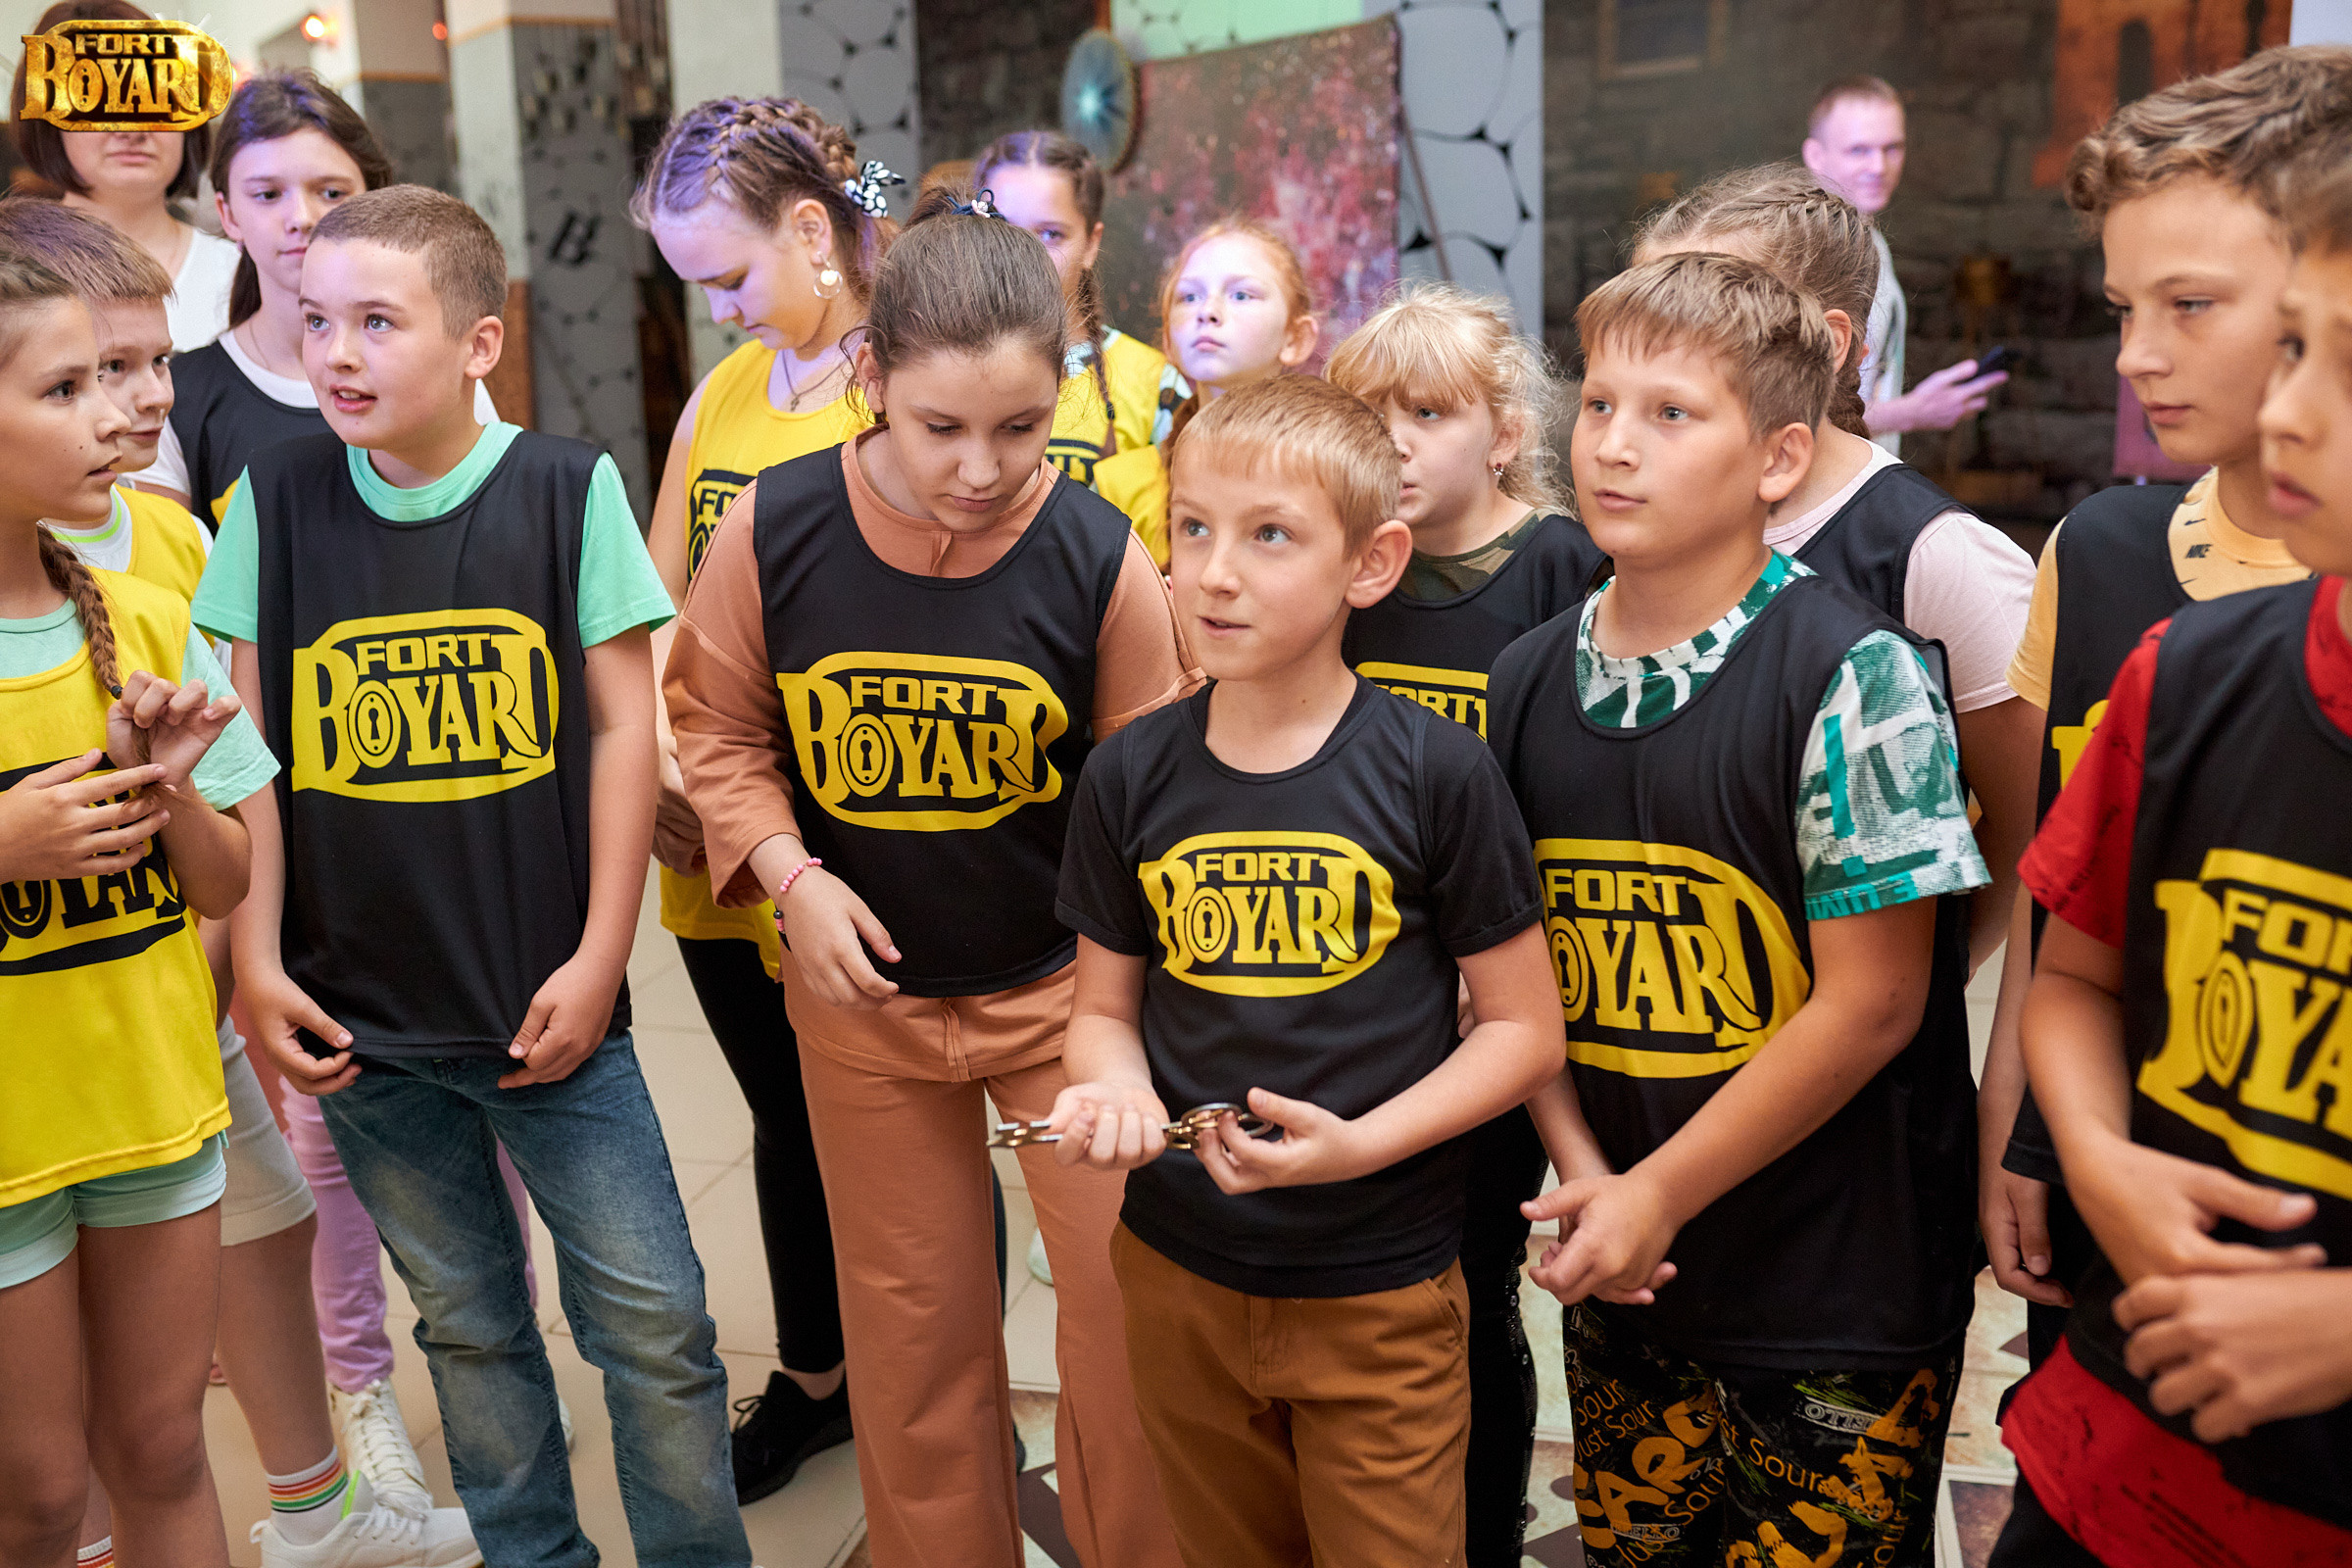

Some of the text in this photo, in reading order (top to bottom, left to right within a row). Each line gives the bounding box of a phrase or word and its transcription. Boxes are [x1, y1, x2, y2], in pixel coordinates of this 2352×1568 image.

[356, 632, 491, 676] FORT
[291, 632, 560, 792] BOYARD
[850, 675, 998, 716] FORT
[776, 672, 1069, 808] BOYARD
[1196, 852, 1321, 883] FORT
[1544, 867, 1688, 917] FORT
[1138, 855, 1401, 974] BOYARD
[1545, 879, 1811, 1049] OYARD
[1604, 1399, 1655, 1439] Sour
[1747, 1436, 1825, 1494] Sour
